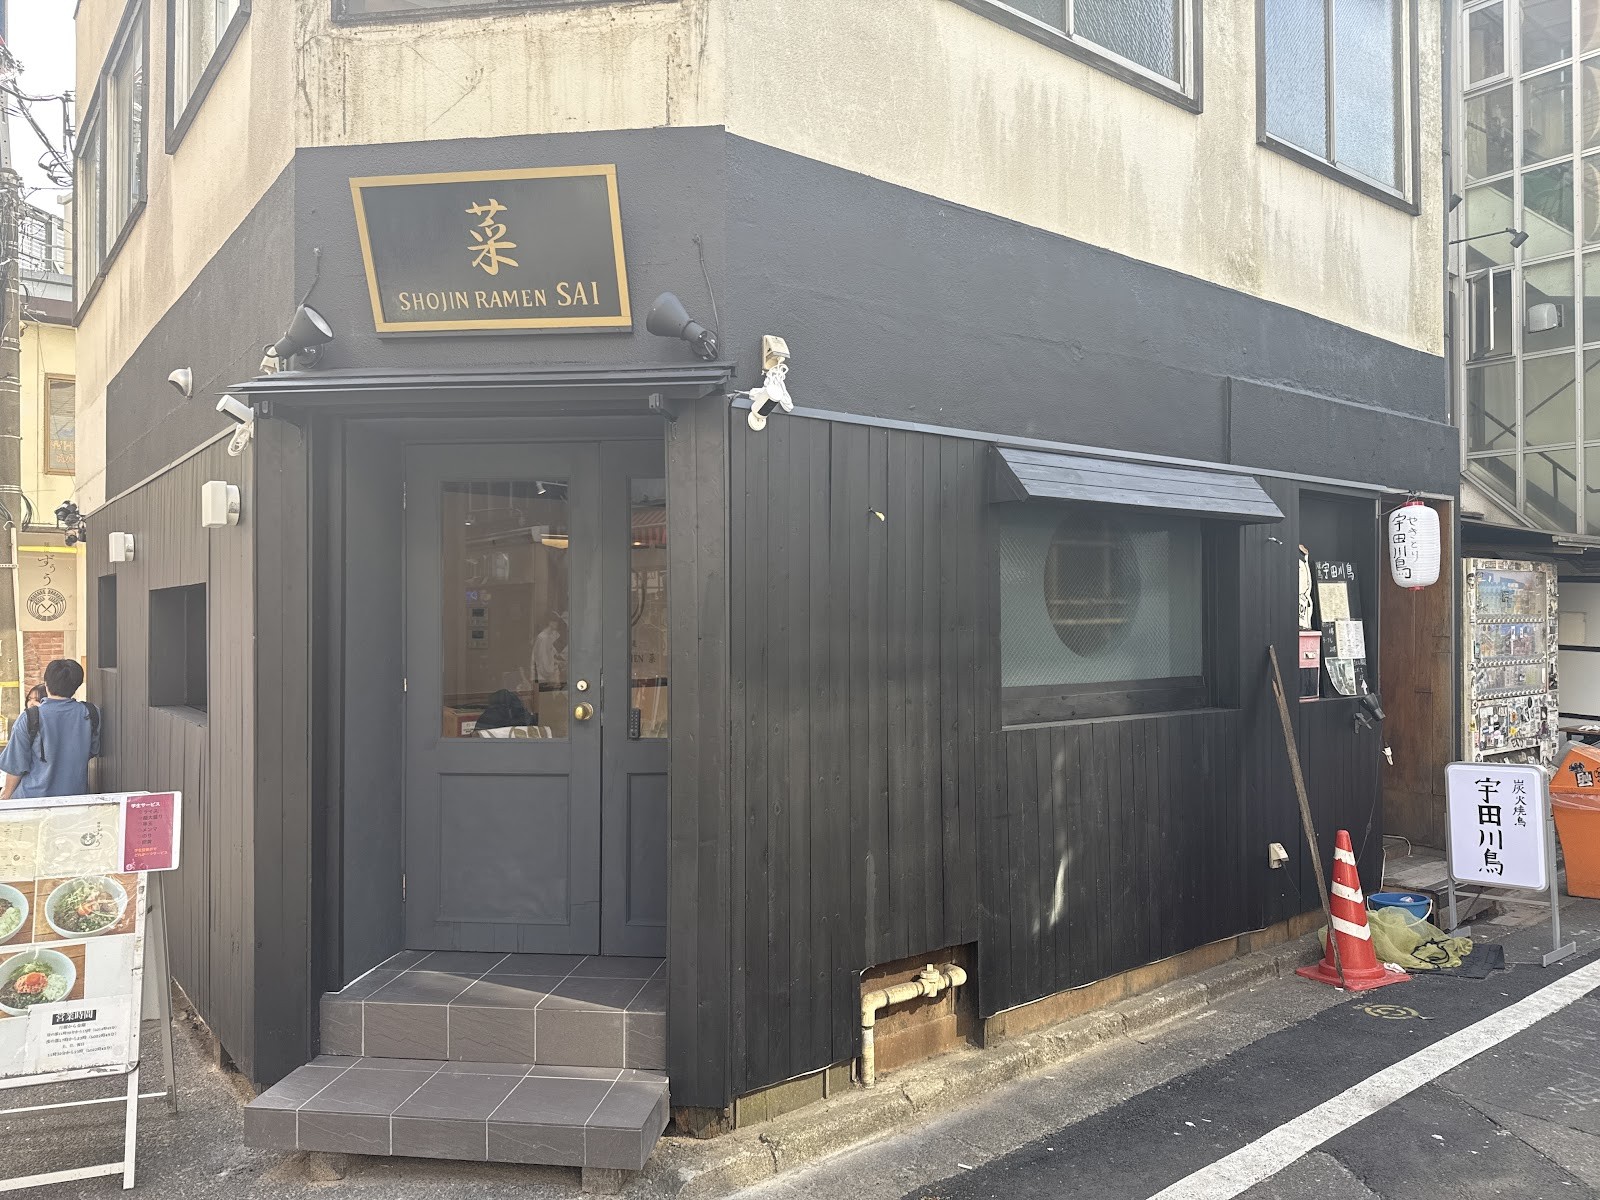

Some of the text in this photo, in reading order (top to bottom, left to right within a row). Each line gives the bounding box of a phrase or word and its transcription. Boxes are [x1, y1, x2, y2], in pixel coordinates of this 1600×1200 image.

[465, 198, 519, 276] 菜
[398, 281, 600, 311] SHOJIN RAMEN SAI
[1392, 512, 1412, 579] 宇田川鳥
[1406, 516, 1419, 562] やきとり
[1321, 561, 1355, 581] 宇田川鳥
[1474, 777, 1504, 877] 宇田川鳥
[1511, 779, 1527, 827] 炭火焼鳥
